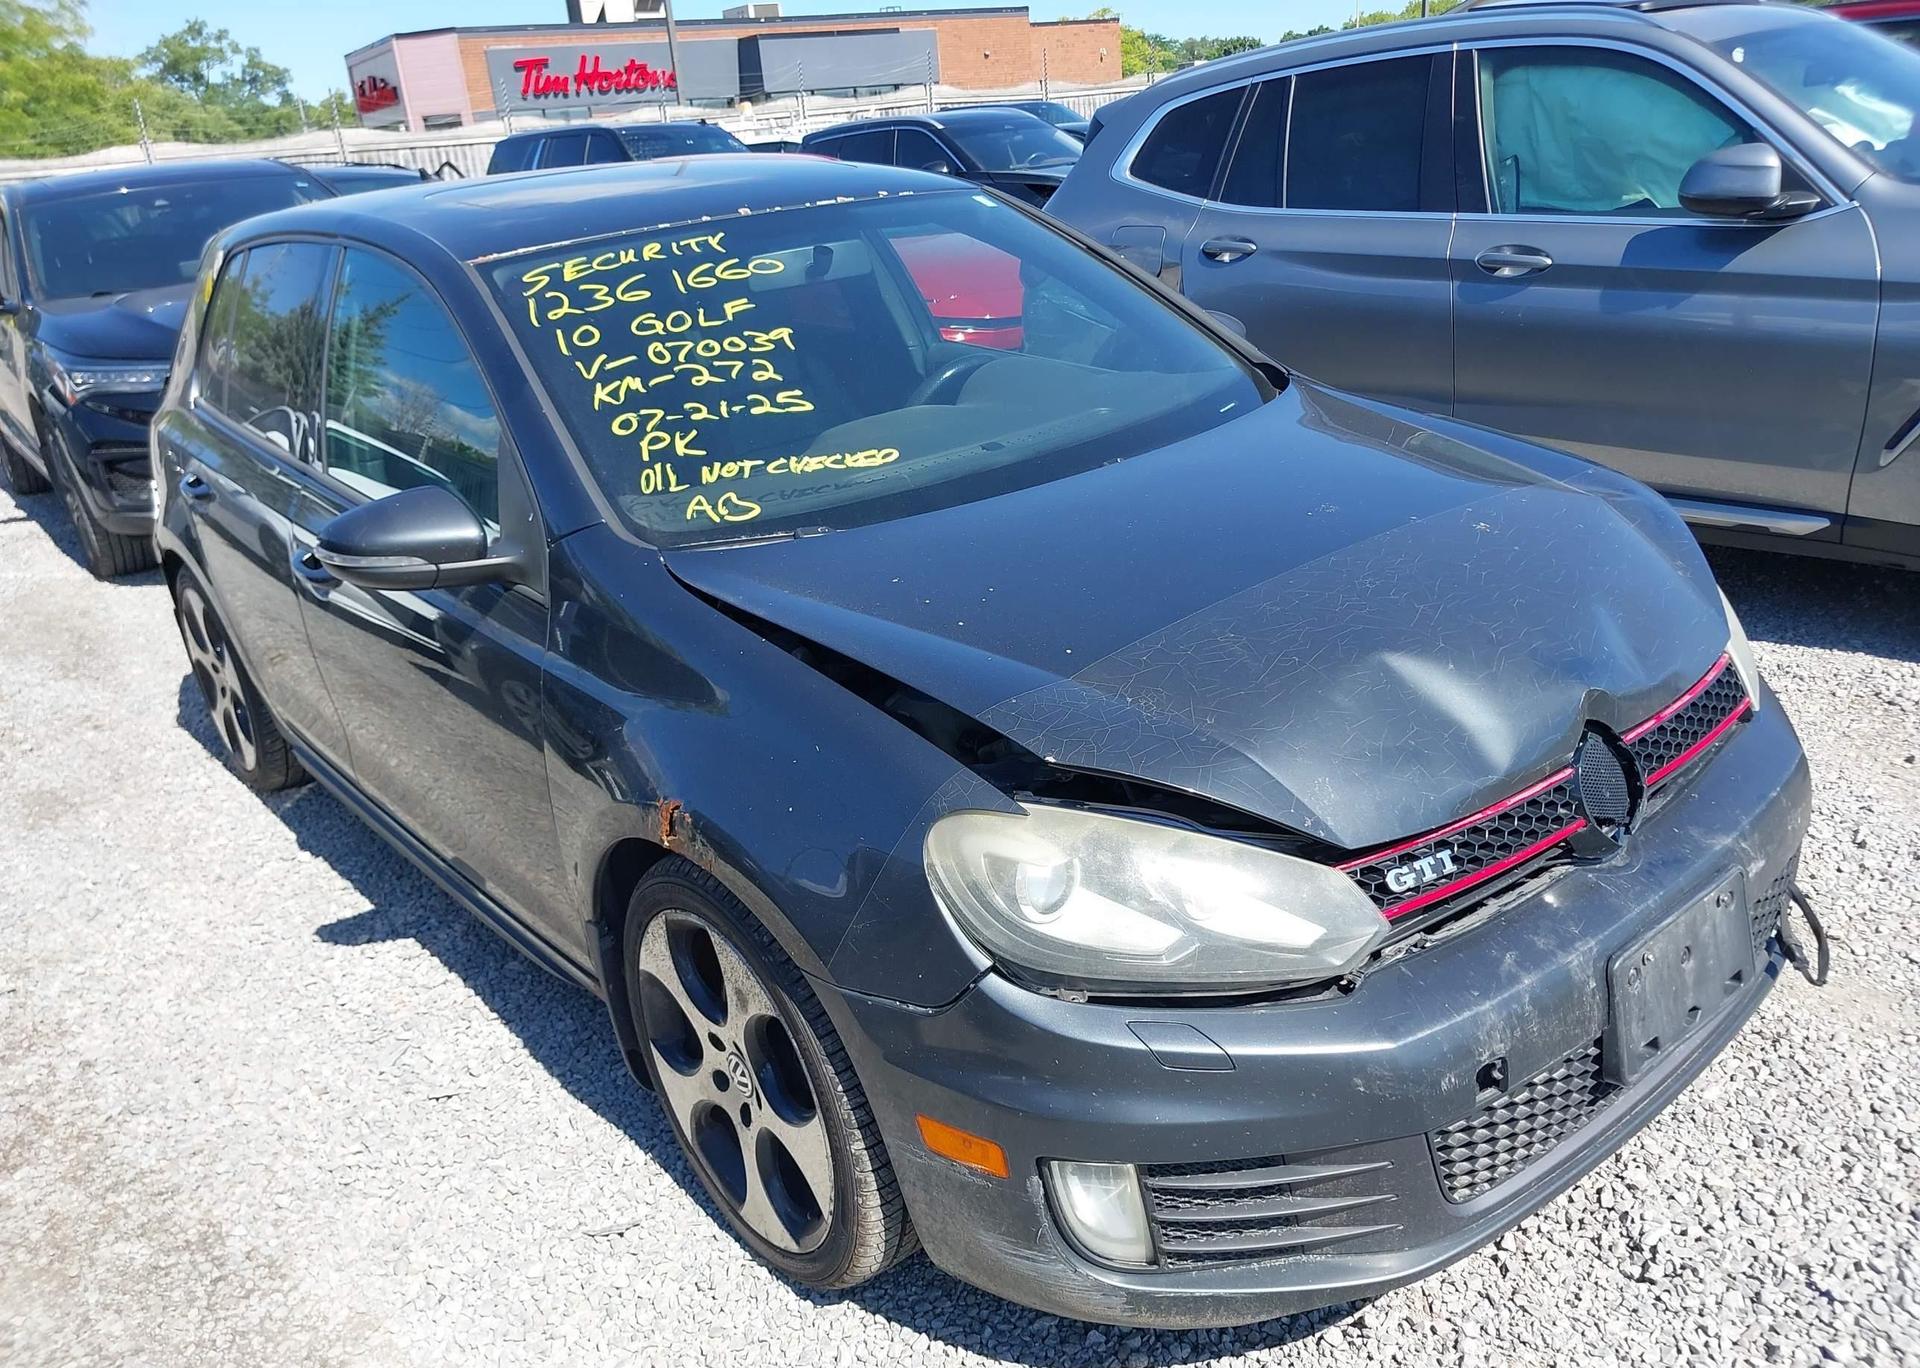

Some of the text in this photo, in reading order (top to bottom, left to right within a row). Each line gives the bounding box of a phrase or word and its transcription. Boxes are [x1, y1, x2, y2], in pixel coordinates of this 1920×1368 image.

[513, 58, 569, 97] Tim
[522, 232, 727, 296] SECURITY
[526, 258, 785, 327] 1236 1660
[555, 298, 756, 356] 10 GOLF
[611, 389, 815, 436] 07-21-25
[639, 429, 708, 462] PK
[640, 464, 690, 495] OIL
[701, 459, 765, 486] NOT
[1385, 848, 1458, 893] GTI
